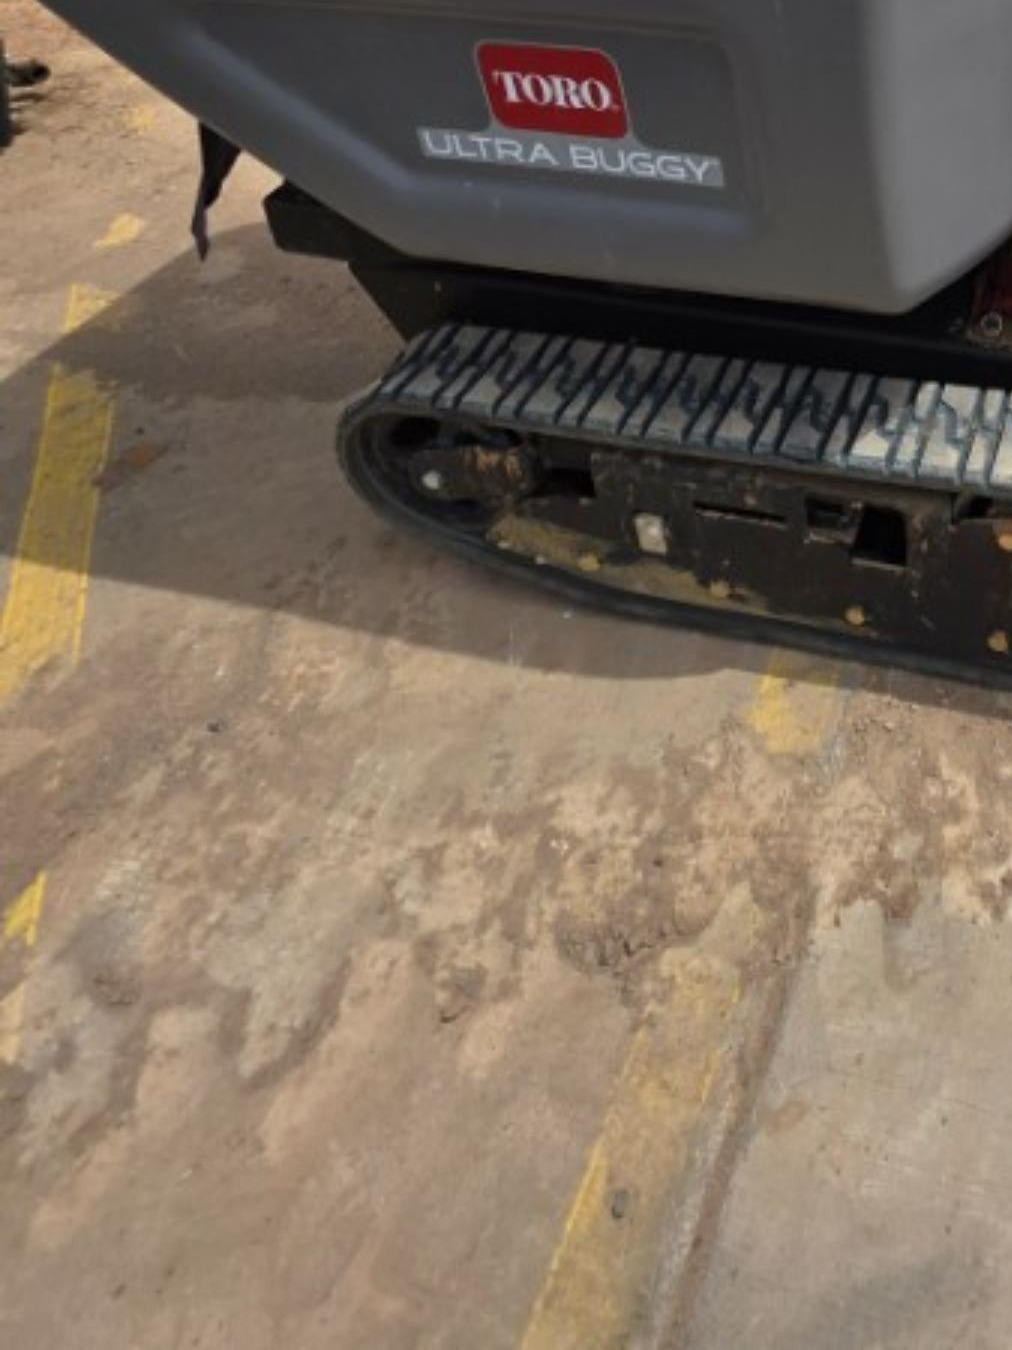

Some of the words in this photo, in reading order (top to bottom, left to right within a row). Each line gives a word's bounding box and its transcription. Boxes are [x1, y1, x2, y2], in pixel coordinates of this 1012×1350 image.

[491, 68, 613, 112] TORO
[421, 130, 560, 167] ULTRA
[568, 143, 713, 185] BUGGY
